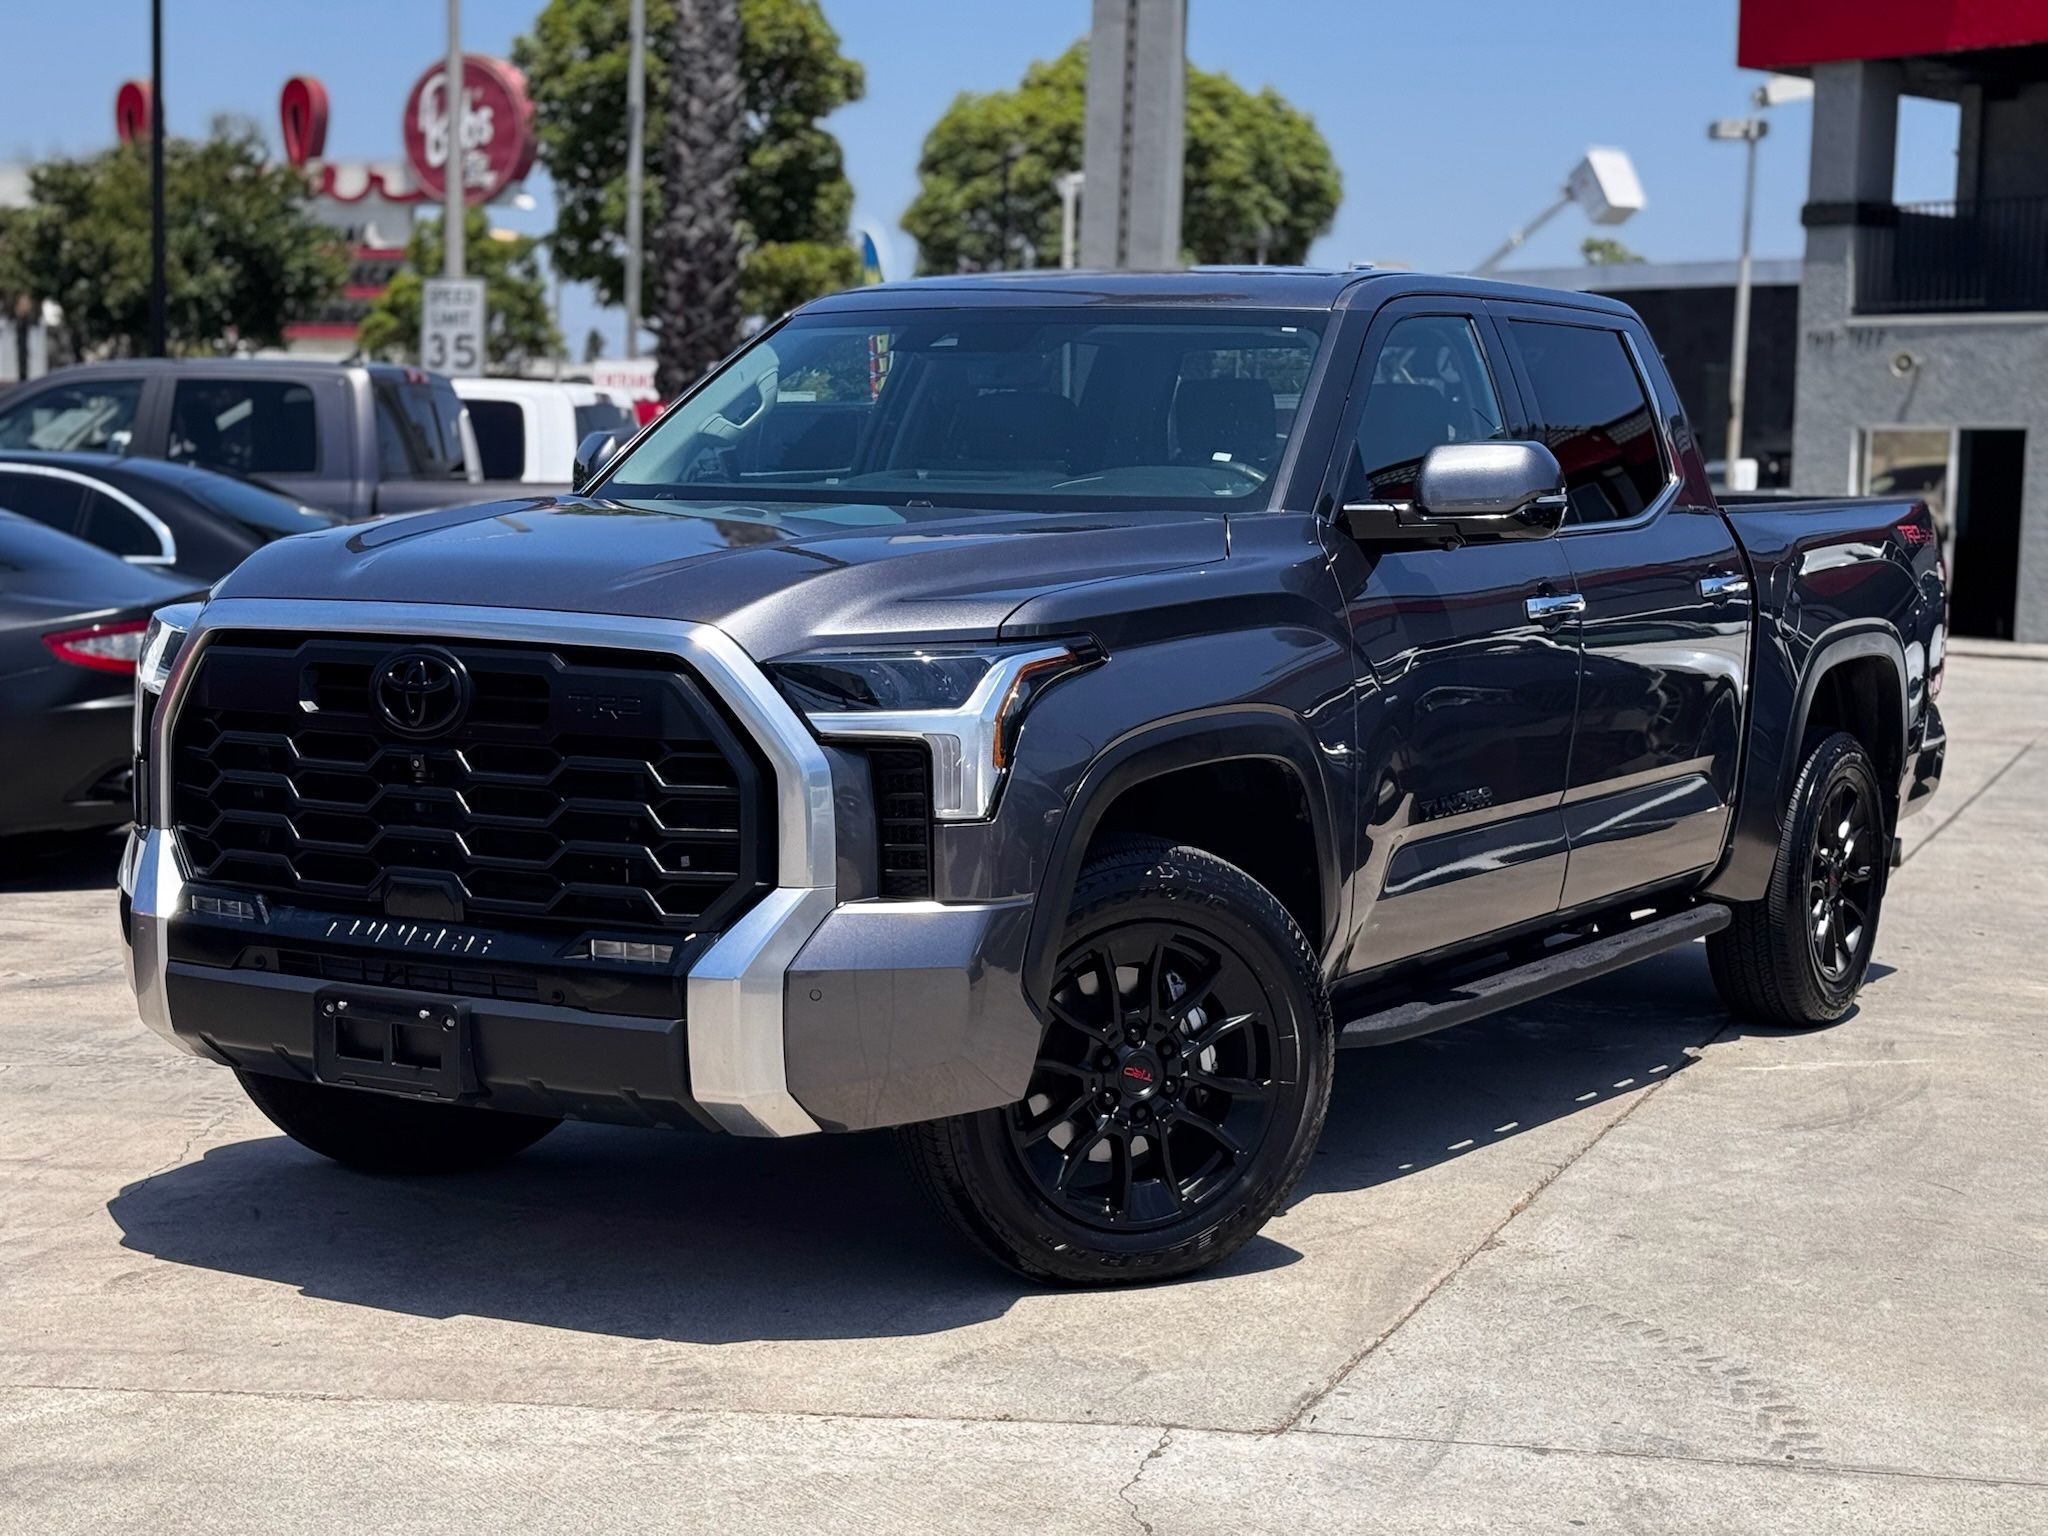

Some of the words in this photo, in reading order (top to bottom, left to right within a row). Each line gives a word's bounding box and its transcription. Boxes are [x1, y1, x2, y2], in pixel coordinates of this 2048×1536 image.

[431, 289, 475, 304] SPEED
[431, 311, 470, 327] LIMIT
[428, 332, 477, 368] 35
[1896, 524, 1921, 544] TRD
[567, 694, 641, 720] TRD
